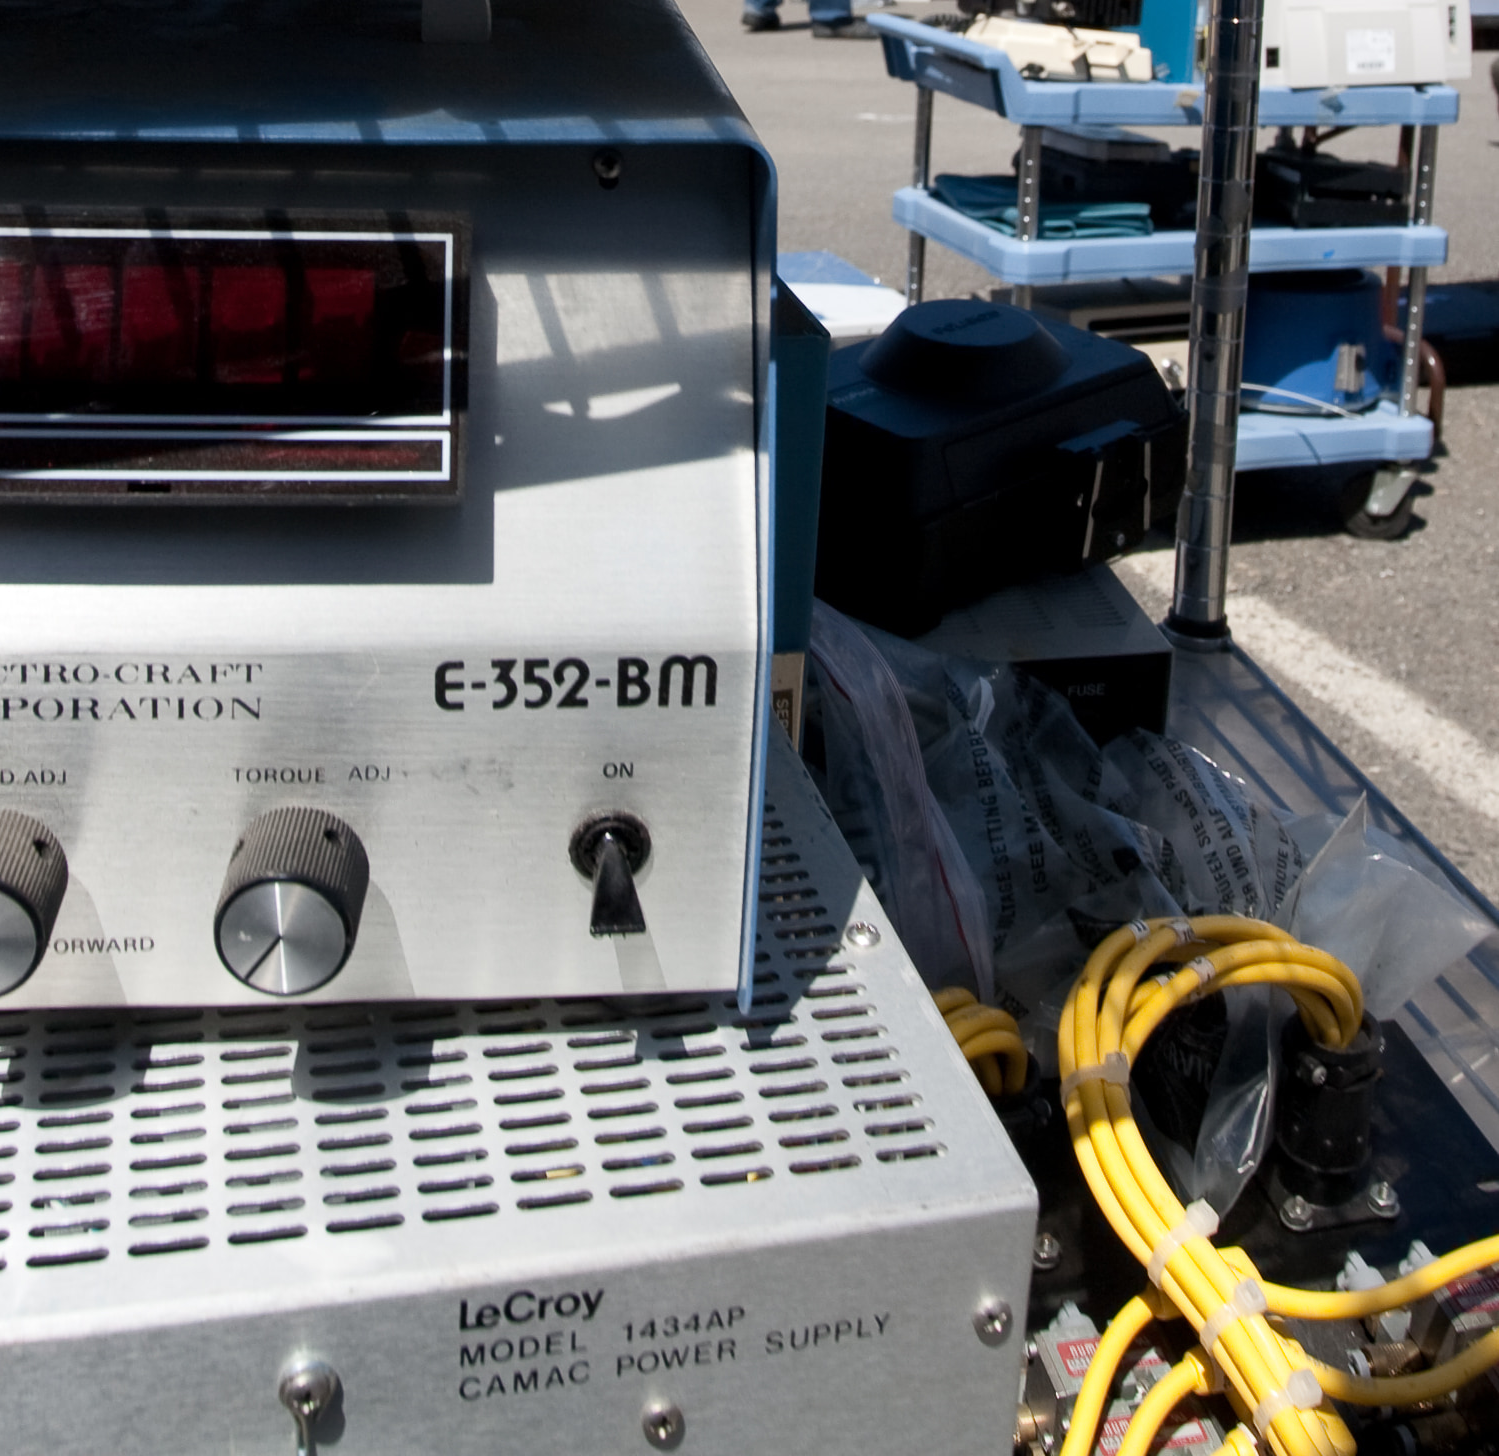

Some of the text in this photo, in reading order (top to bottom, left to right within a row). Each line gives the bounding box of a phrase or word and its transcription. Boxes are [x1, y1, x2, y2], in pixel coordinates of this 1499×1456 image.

[433, 654, 718, 711] E-352-BM
[1067, 680, 1107, 697] FUSE
[232, 763, 391, 786] TORQUE ADJ
[601, 760, 635, 781] ON
[1173, 788, 1199, 817] DAS
[979, 796, 1011, 865] SETTING
[1192, 820, 1210, 848] SIE
[1207, 807, 1234, 840] ALLE
[1029, 841, 1049, 894] (SEE
[1225, 844, 1251, 878] UND
[47, 935, 156, 956] ORWARD
[458, 1285, 605, 1332] LeCroy
[459, 1306, 747, 1369] MODEL 1434AP
[458, 1311, 892, 1403] CAMAC POWER SUPPLY
